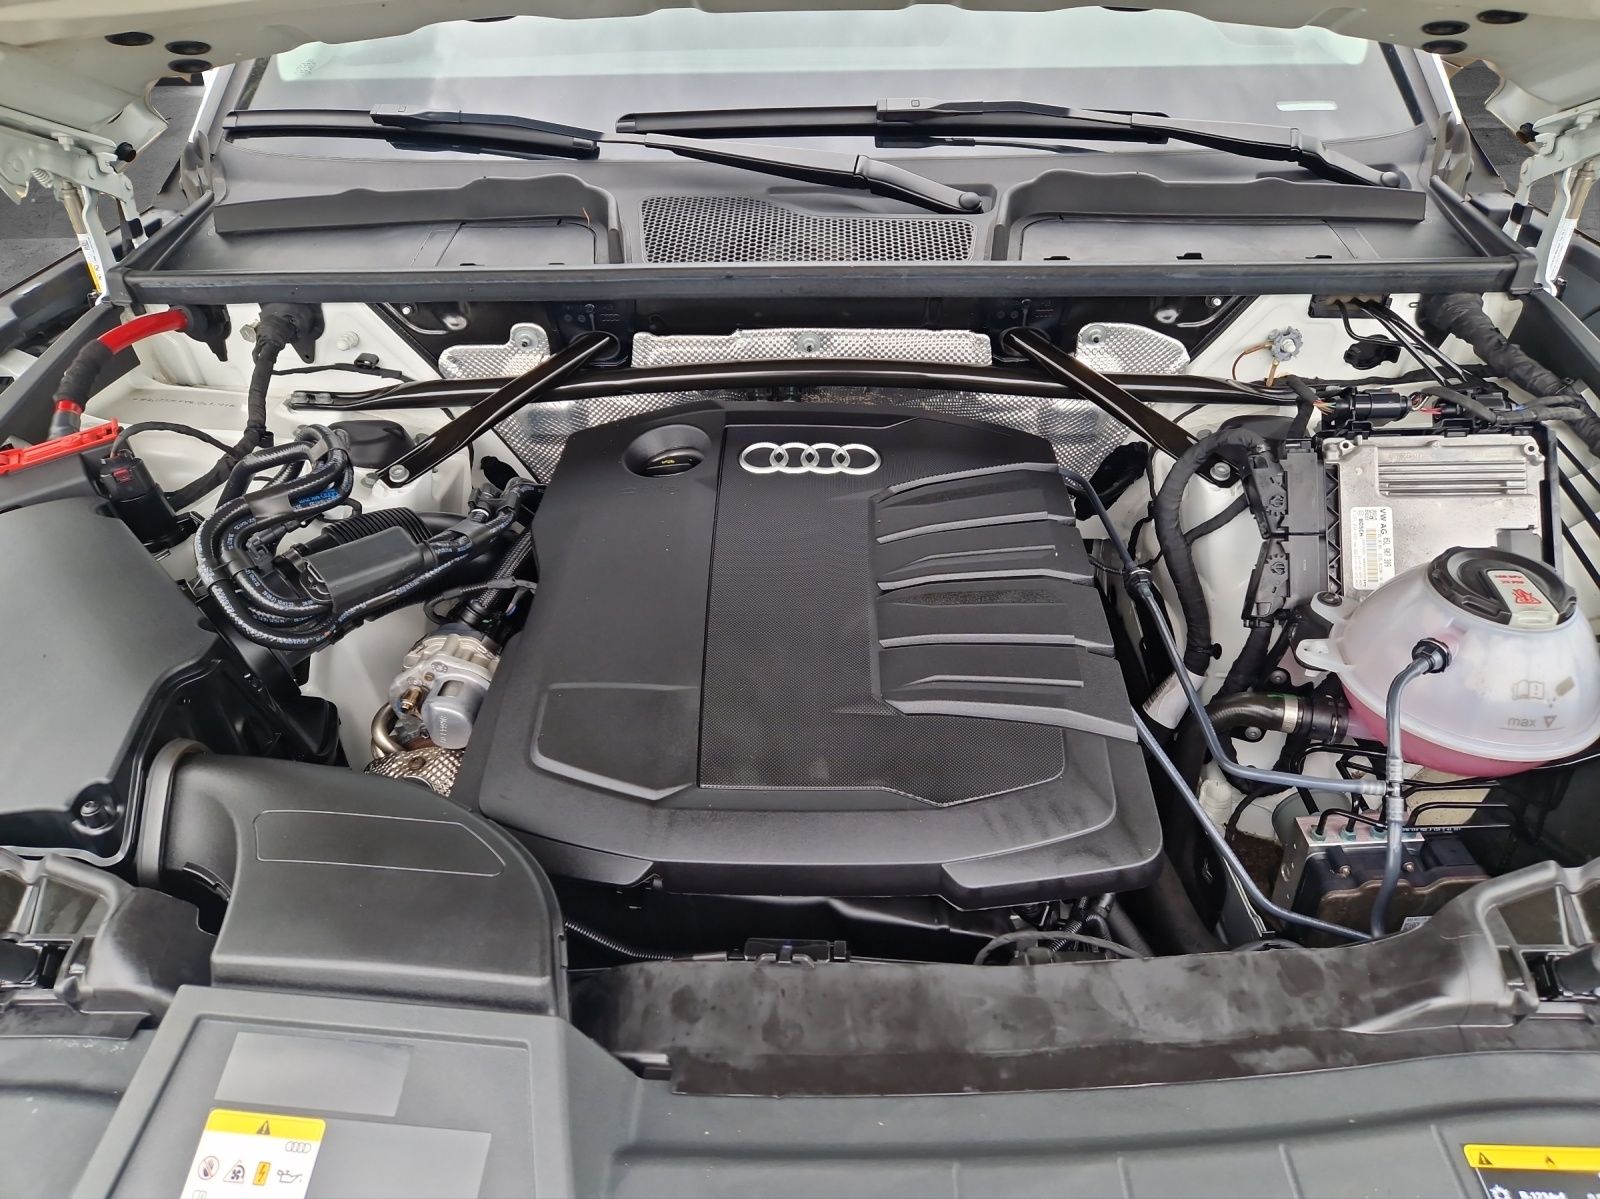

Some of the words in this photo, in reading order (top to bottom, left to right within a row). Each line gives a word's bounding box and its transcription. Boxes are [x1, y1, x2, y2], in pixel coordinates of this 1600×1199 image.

[1380, 508, 1387, 521] VW
[1380, 523, 1388, 535] AG
[1507, 717, 1536, 727] max
